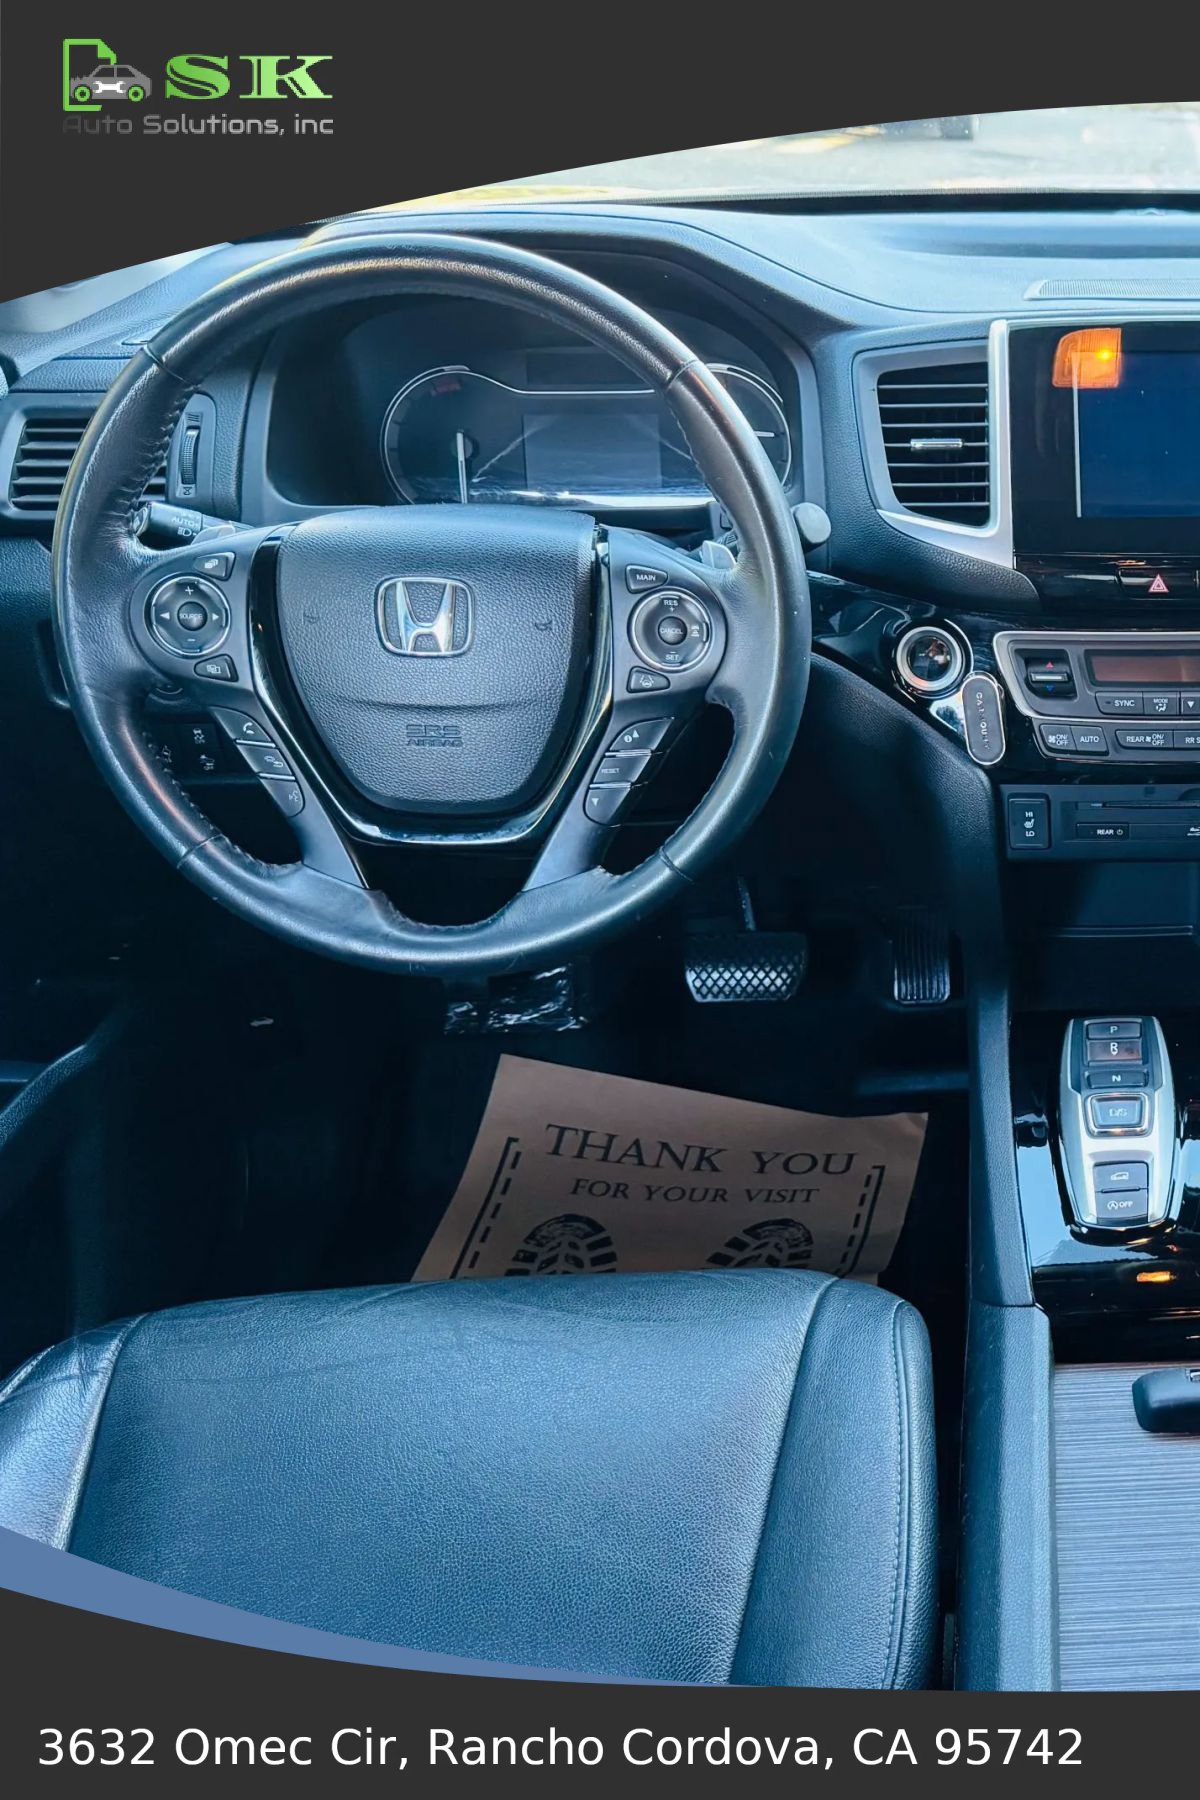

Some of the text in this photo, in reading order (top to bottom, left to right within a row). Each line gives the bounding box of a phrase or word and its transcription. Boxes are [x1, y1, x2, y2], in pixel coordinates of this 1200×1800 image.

[636, 573, 657, 582] MAIN
[179, 612, 203, 620] SOURCE
[658, 627, 683, 635] CANCEL
[1114, 699, 1135, 708] SYNC
[406, 724, 462, 739] SRS
[1185, 737, 1196, 745] RR
[601, 767, 620, 775] RESET
[1096, 828, 1115, 836] REAR
[1110, 1025, 1119, 1034] P
[545, 1124, 859, 1176] THANK YOU
[570, 1178, 821, 1204] FOR YOUR VISIT
[1118, 1201, 1133, 1209] OFF
